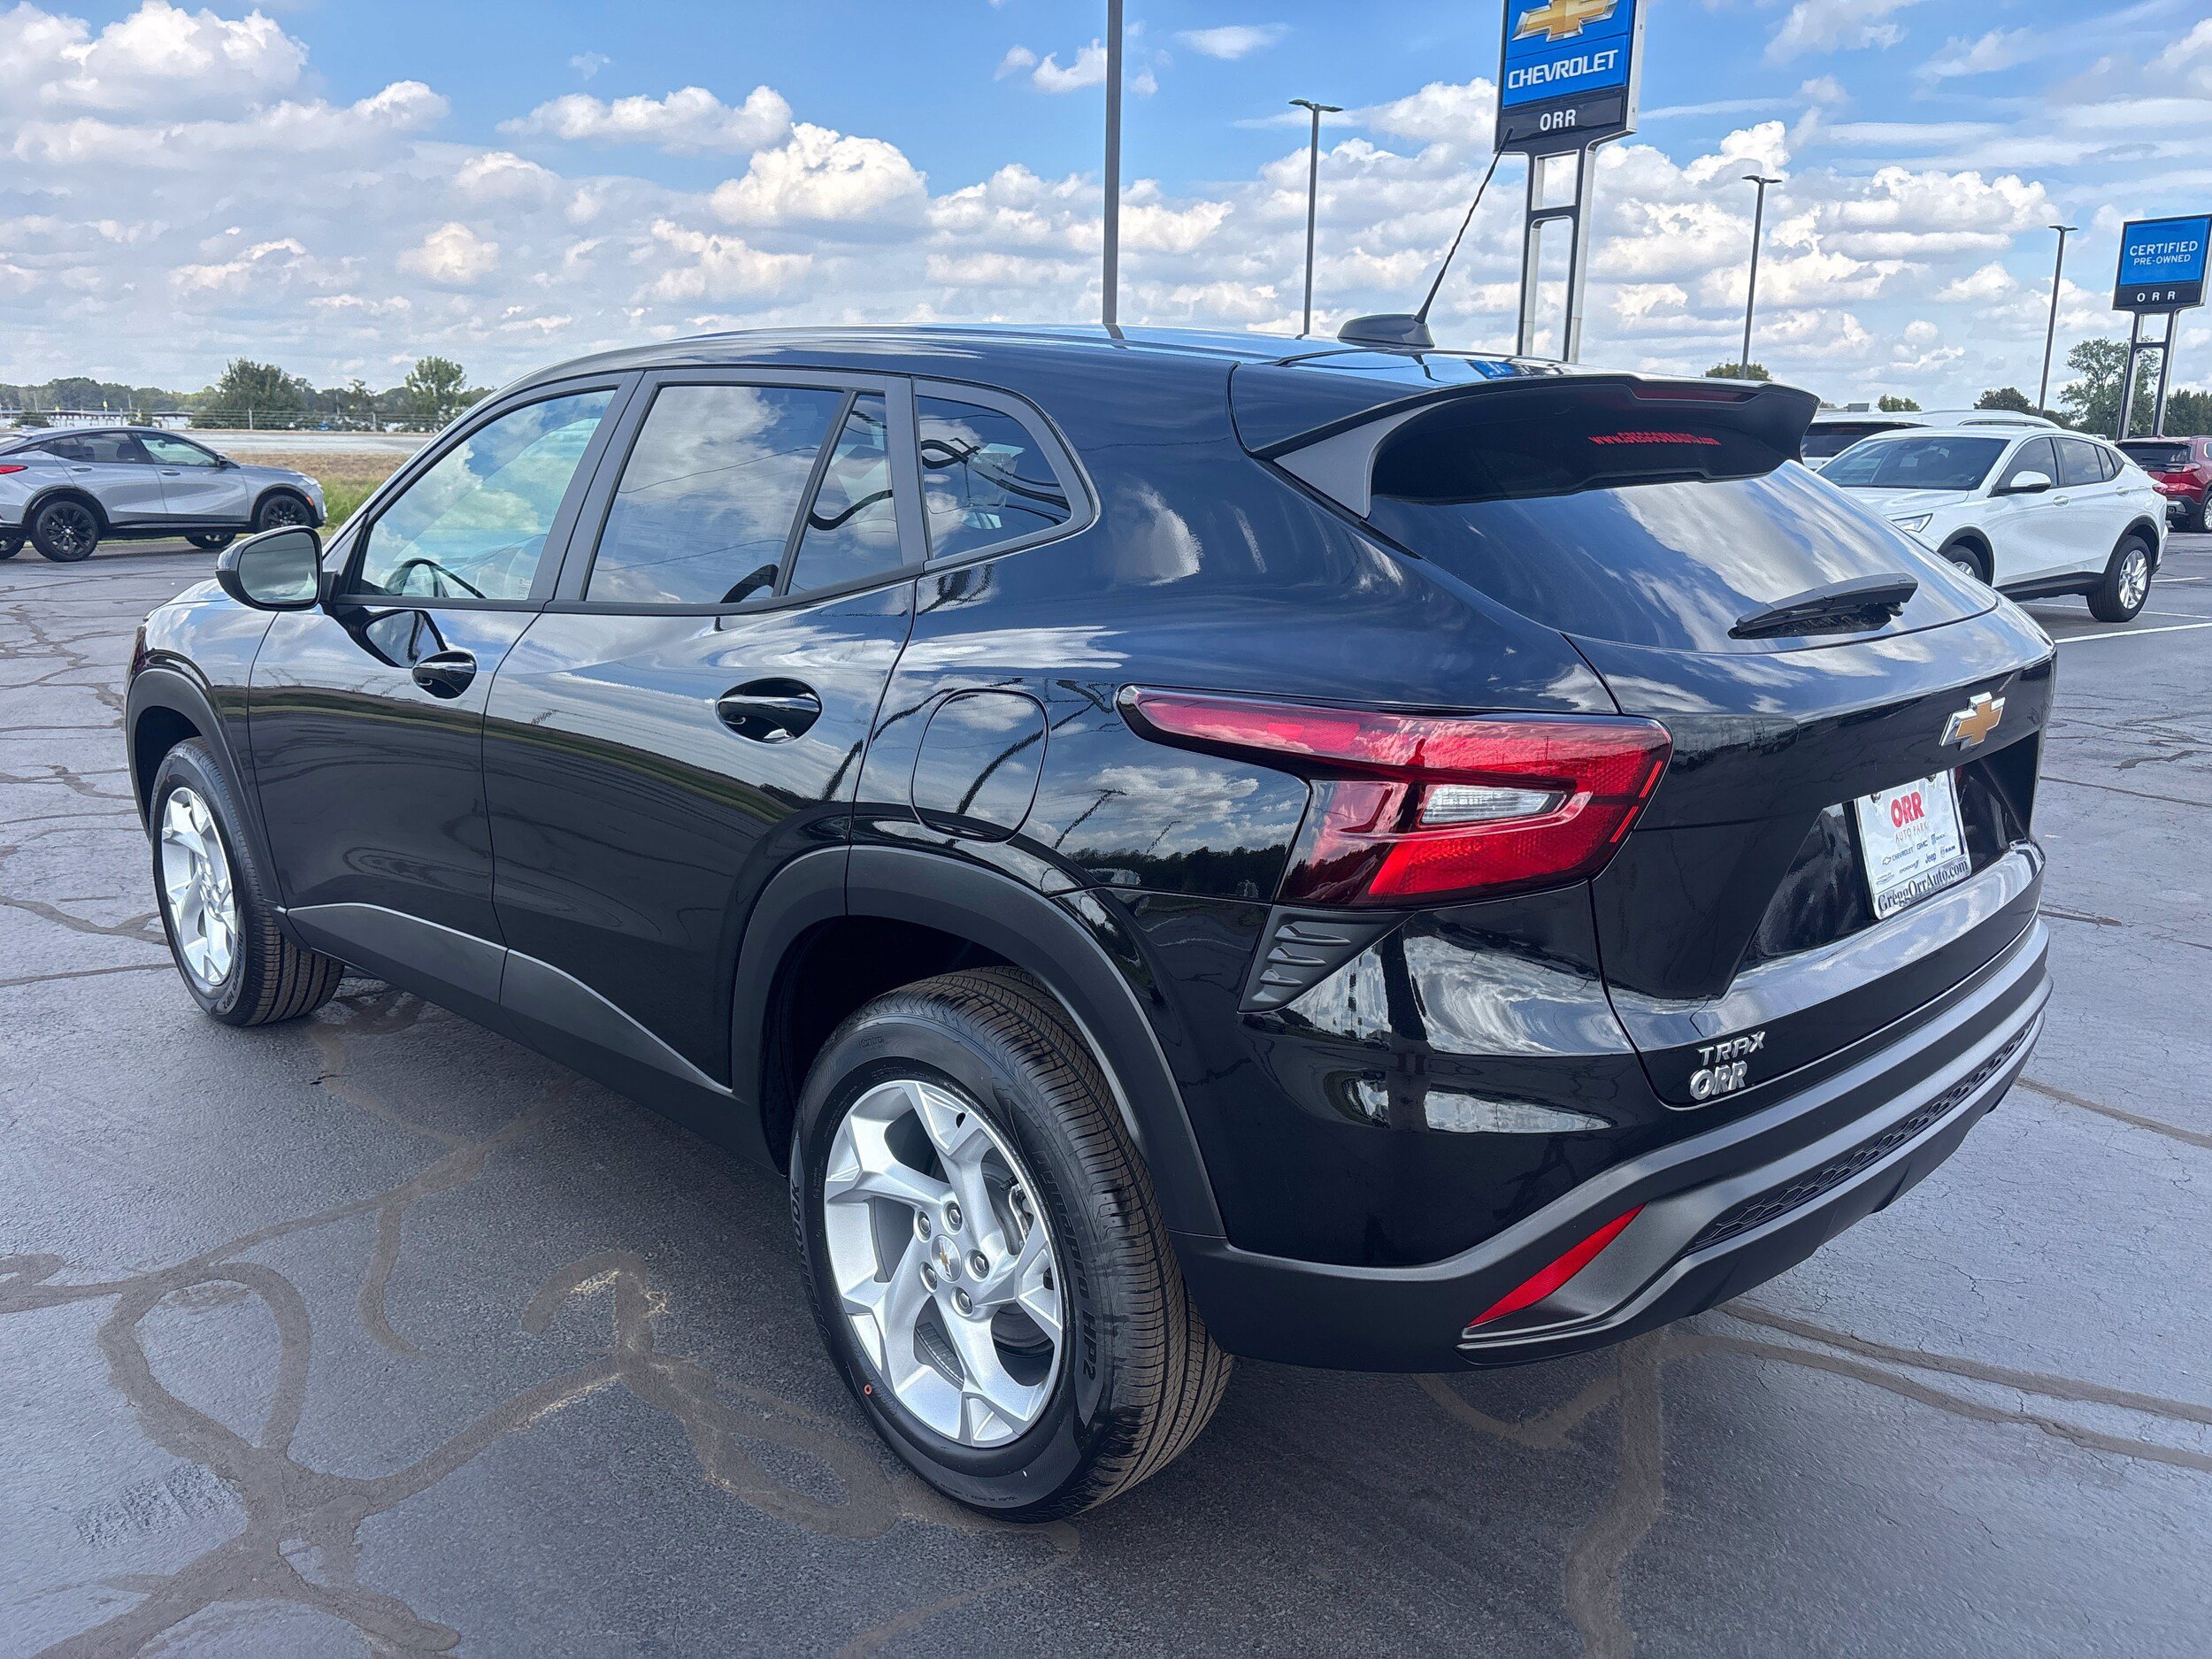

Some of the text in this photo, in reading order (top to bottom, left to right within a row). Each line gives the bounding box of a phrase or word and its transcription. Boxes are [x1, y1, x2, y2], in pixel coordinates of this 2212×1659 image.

[1508, 50, 1618, 89] CHEVROLET
[1540, 109, 1576, 131] ORR
[2129, 241, 2199, 257] CERTIFIED
[2133, 254, 2191, 266] PRE-OWNED
[2137, 291, 2176, 303] ORR
[1890, 791, 1925, 828] ORR
[1894, 822, 1929, 842] AUTO PARK
[1892, 847, 1914, 862] CHEVROLET
[1916, 840, 1928, 850] GMC
[1925, 852, 1937, 864] Jeep
[1878, 860, 1968, 913] GreggOrrAuto.com
[1696, 1031, 1765, 1066] TRAX
[1690, 1060, 1747, 1100] ORR
[1081, 1310, 1098, 1381] HP2
